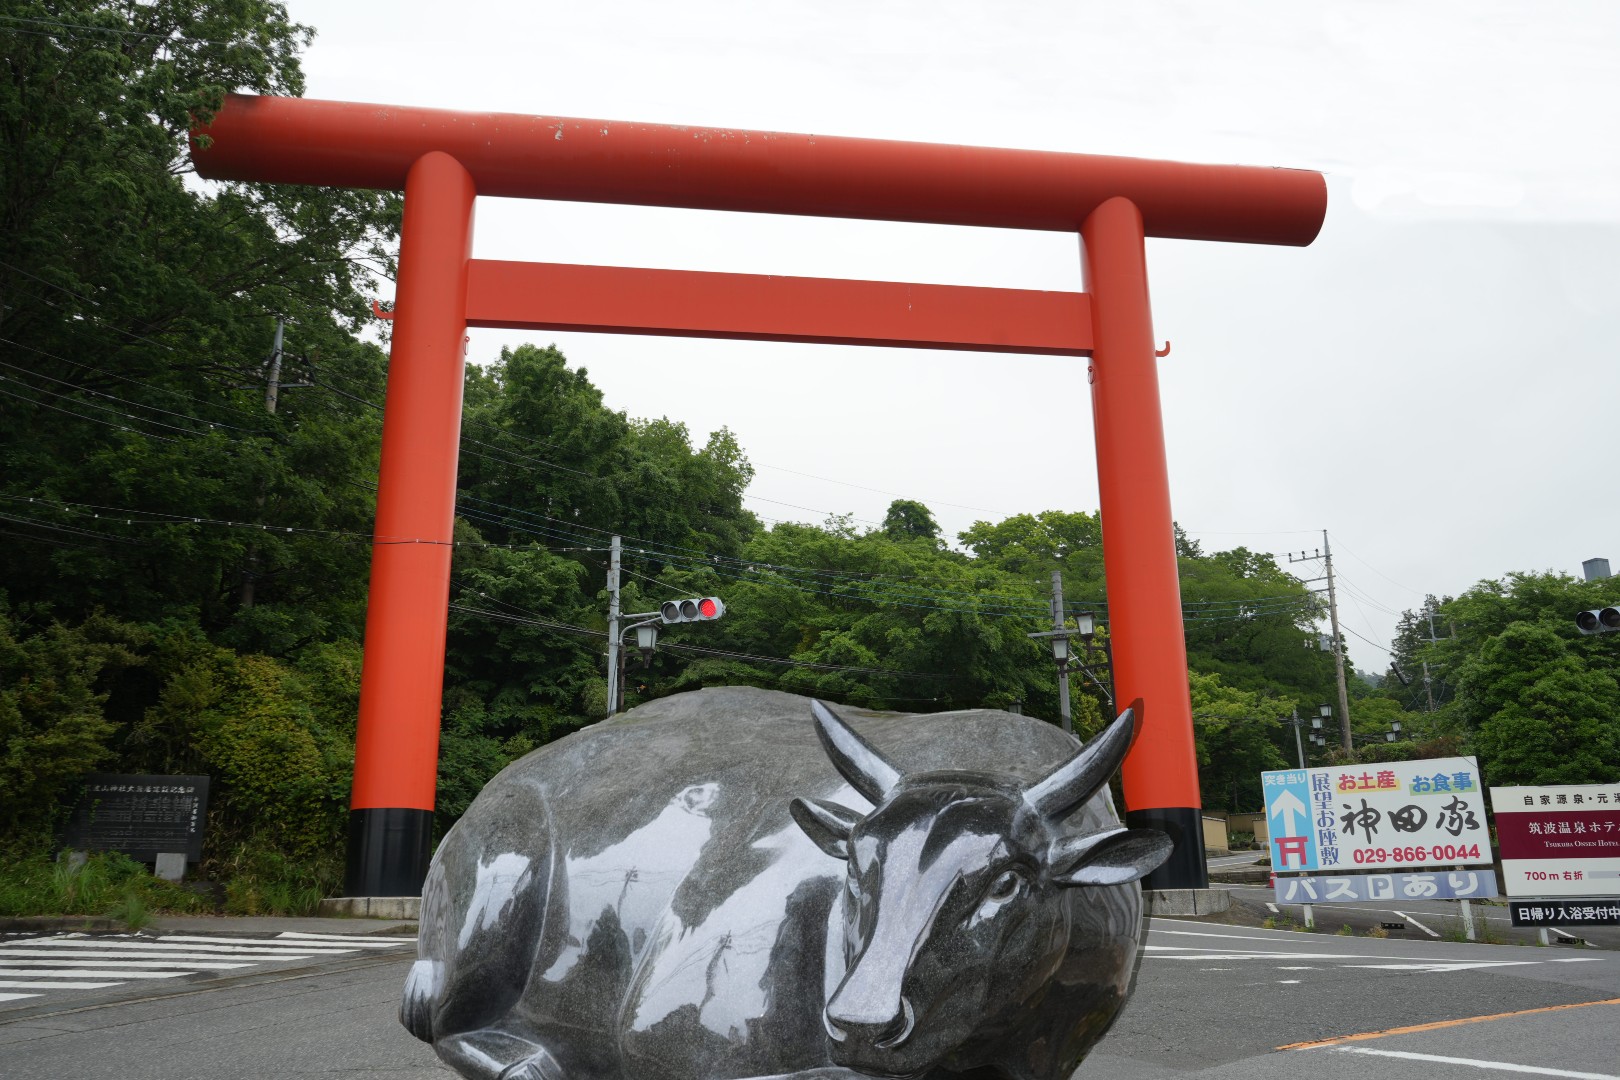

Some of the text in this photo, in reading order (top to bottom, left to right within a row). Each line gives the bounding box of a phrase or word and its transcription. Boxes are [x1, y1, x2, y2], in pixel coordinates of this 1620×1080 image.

[1264, 773, 1306, 786] 突き当り
[1338, 770, 1397, 791] お土産
[1412, 771, 1473, 793] お食事
[1311, 772, 1340, 866] 展望お座敷
[1340, 795, 1481, 845] 神田家
[1528, 821, 1620, 835] 筑波温泉ホテ
[1353, 844, 1480, 864] 029-866-0044
[1518, 906, 1620, 921] 日帰り入浴受付中
